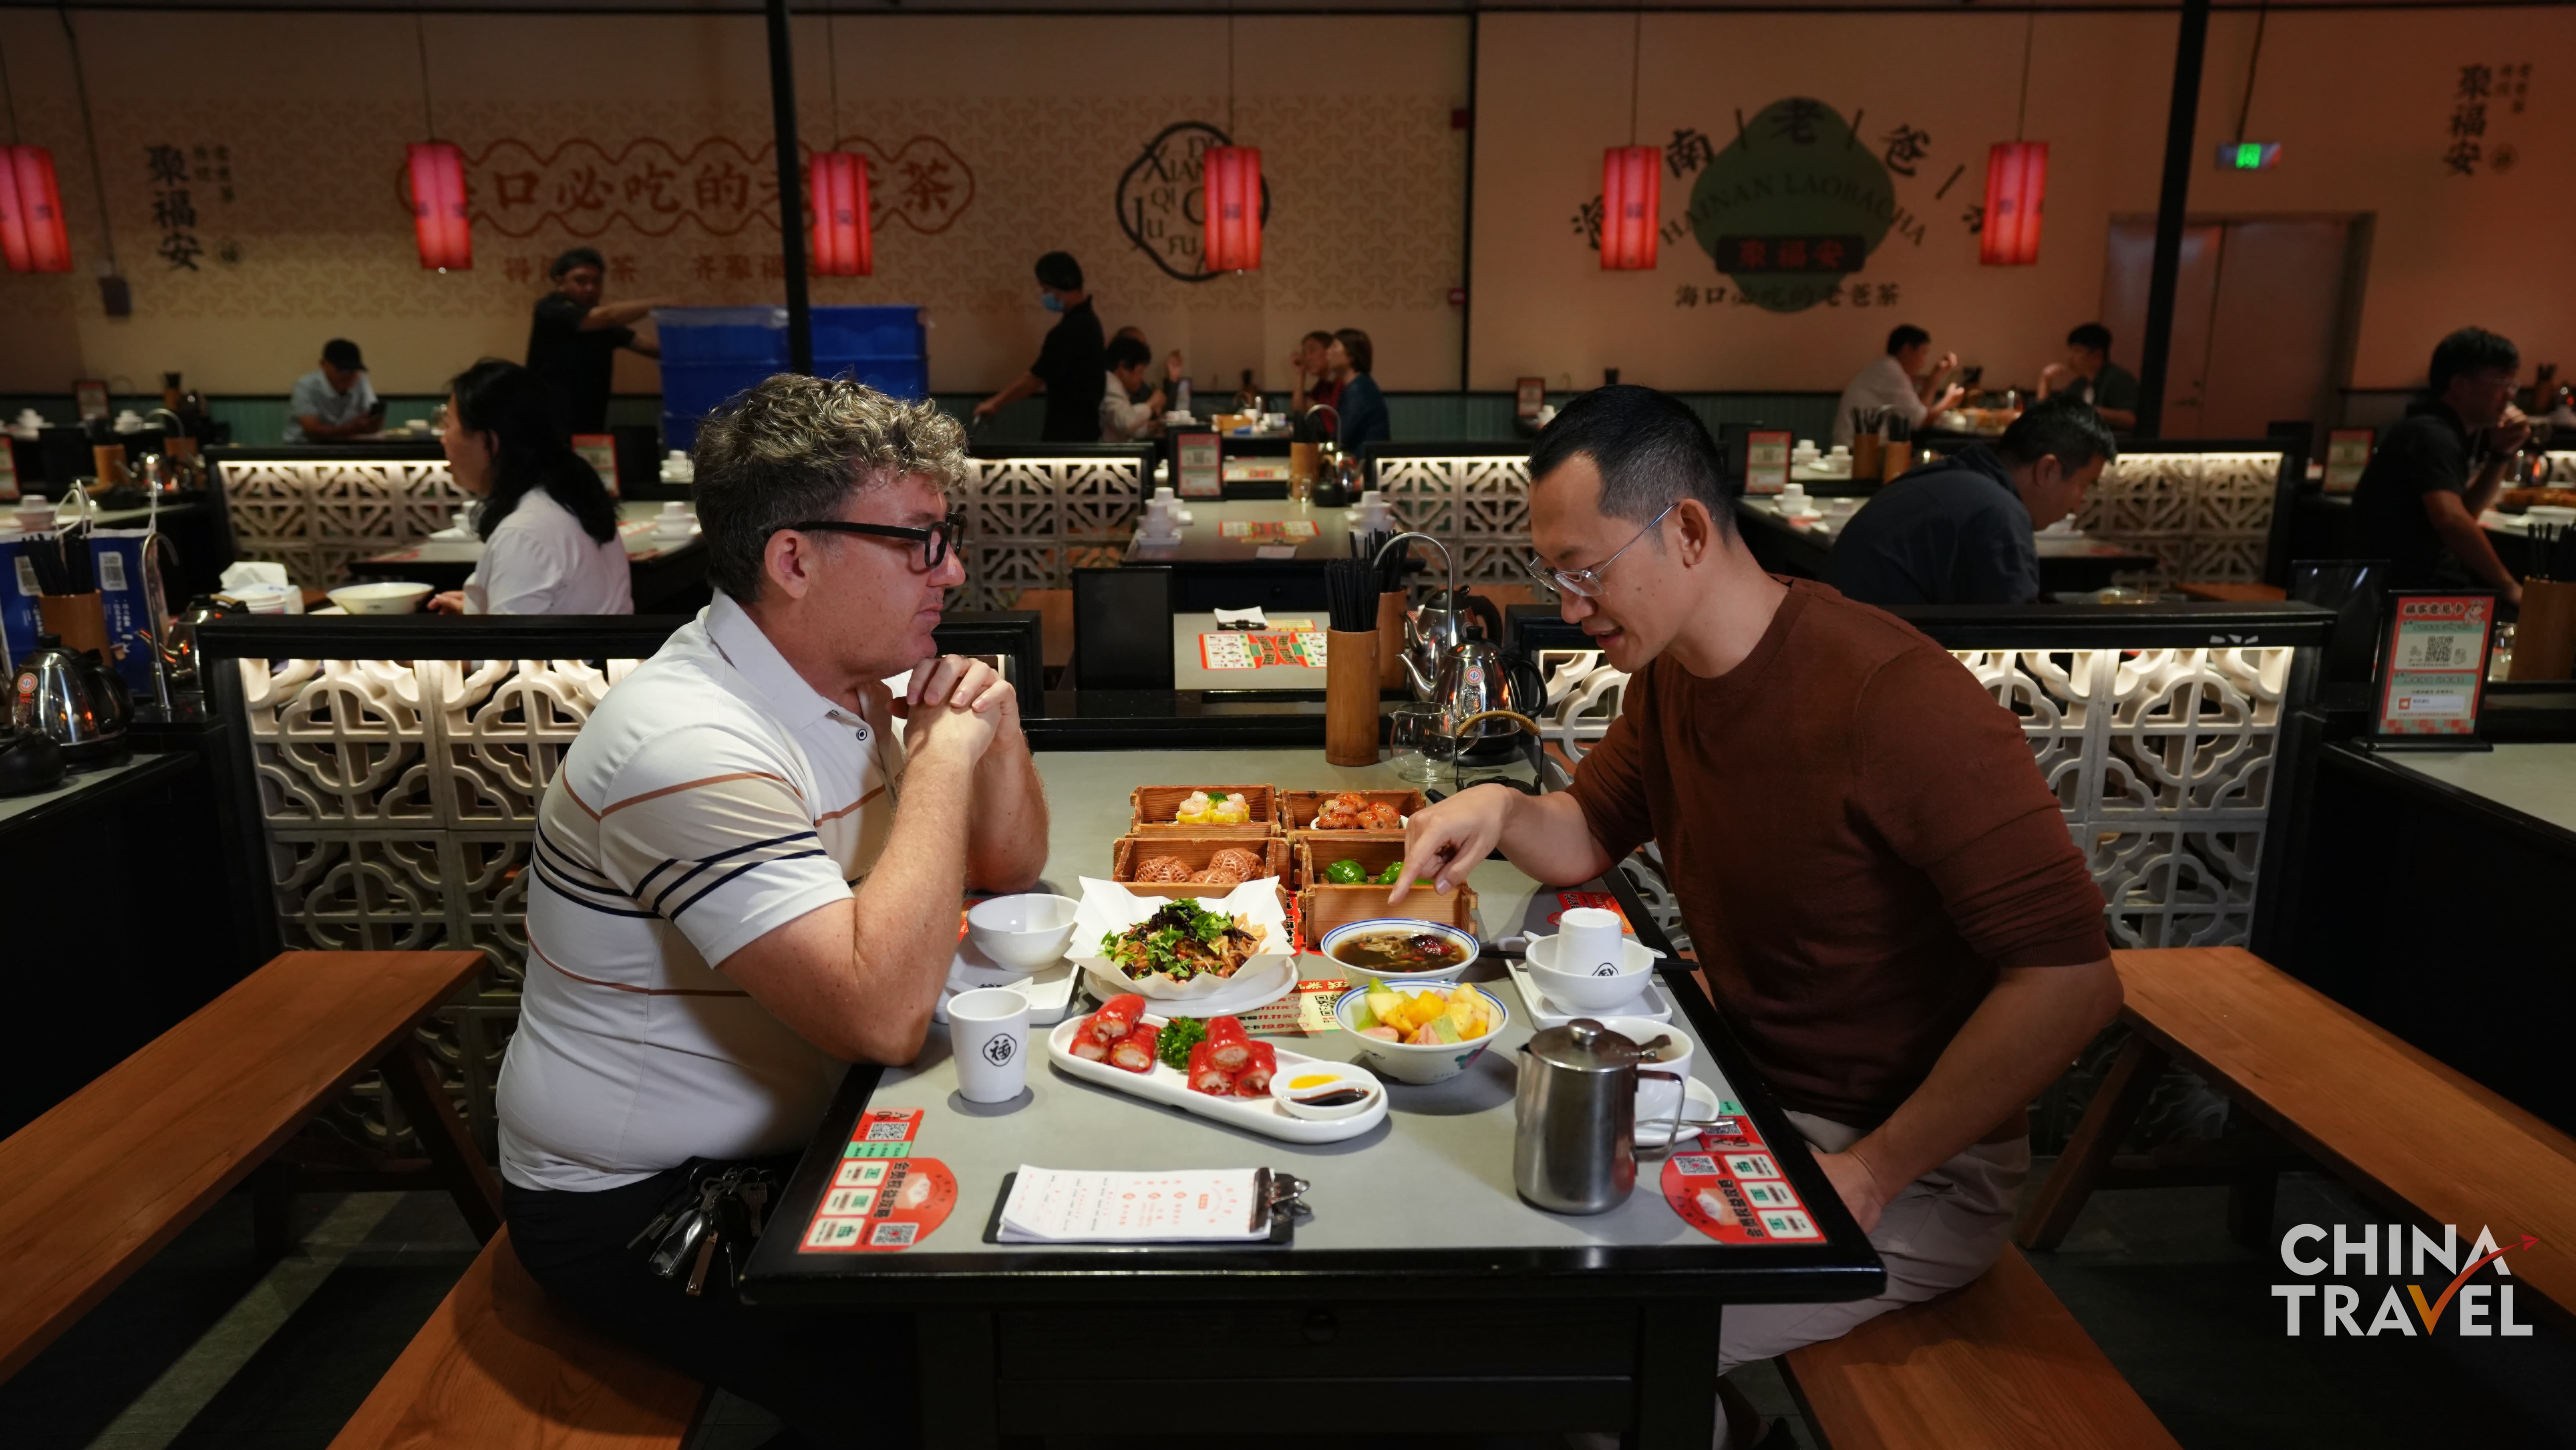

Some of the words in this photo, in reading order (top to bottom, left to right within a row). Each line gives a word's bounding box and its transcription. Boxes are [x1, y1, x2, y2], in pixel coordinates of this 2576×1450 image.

[2443, 64, 2491, 176] 聚福安
[146, 143, 203, 271] 聚福安
[1661, 173, 1775, 246] HAINAN
[1785, 172, 1927, 247] LAOBACHA
[1739, 239, 1844, 269] 聚福安
[990, 1039, 1011, 1061] 福
[873, 1162, 911, 1218] 会员权益攻略
[1717, 1179, 1765, 1238] 会员权益攻略
